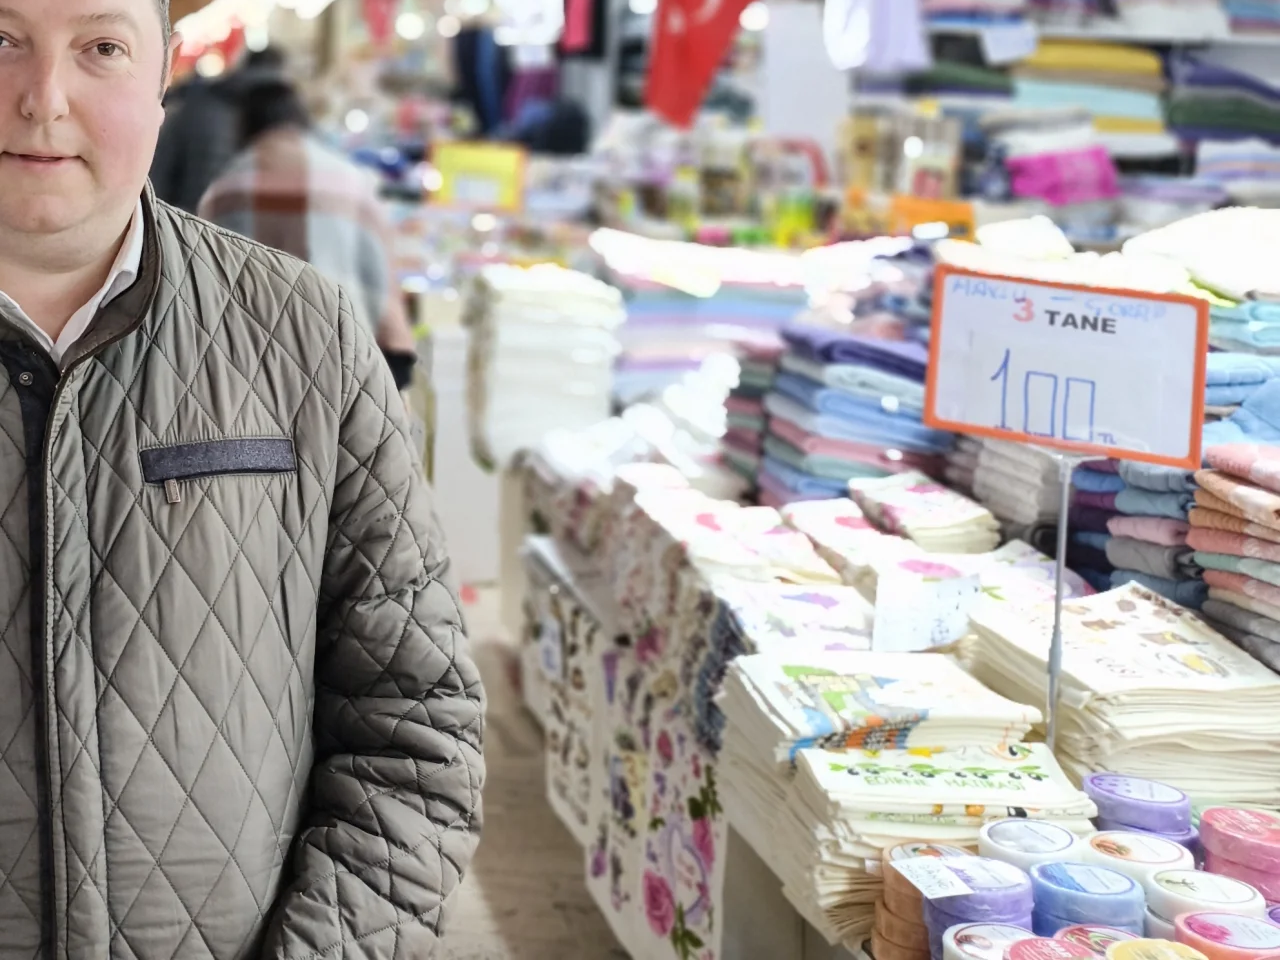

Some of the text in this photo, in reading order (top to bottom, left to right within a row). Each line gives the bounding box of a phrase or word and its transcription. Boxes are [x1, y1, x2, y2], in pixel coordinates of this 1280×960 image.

[1013, 298, 1118, 334] 3 TANE
[990, 348, 1096, 442] 100
